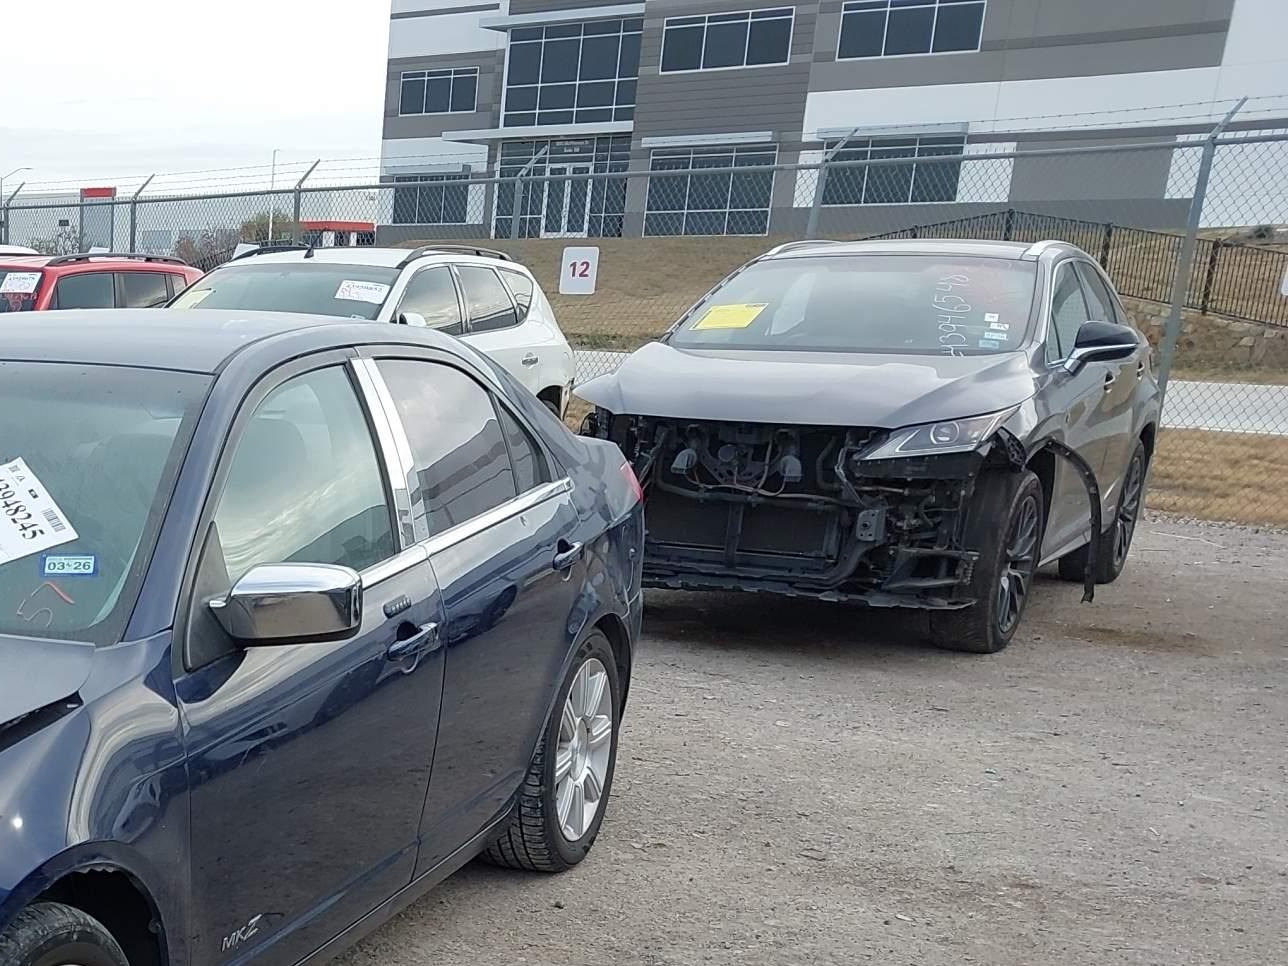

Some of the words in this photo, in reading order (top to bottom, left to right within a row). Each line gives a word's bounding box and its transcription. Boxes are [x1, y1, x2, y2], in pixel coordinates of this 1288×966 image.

[569, 261, 590, 278] 12
[47, 561, 65, 571] 03
[73, 561, 91, 571] 26
[221, 913, 263, 952] MKZ
